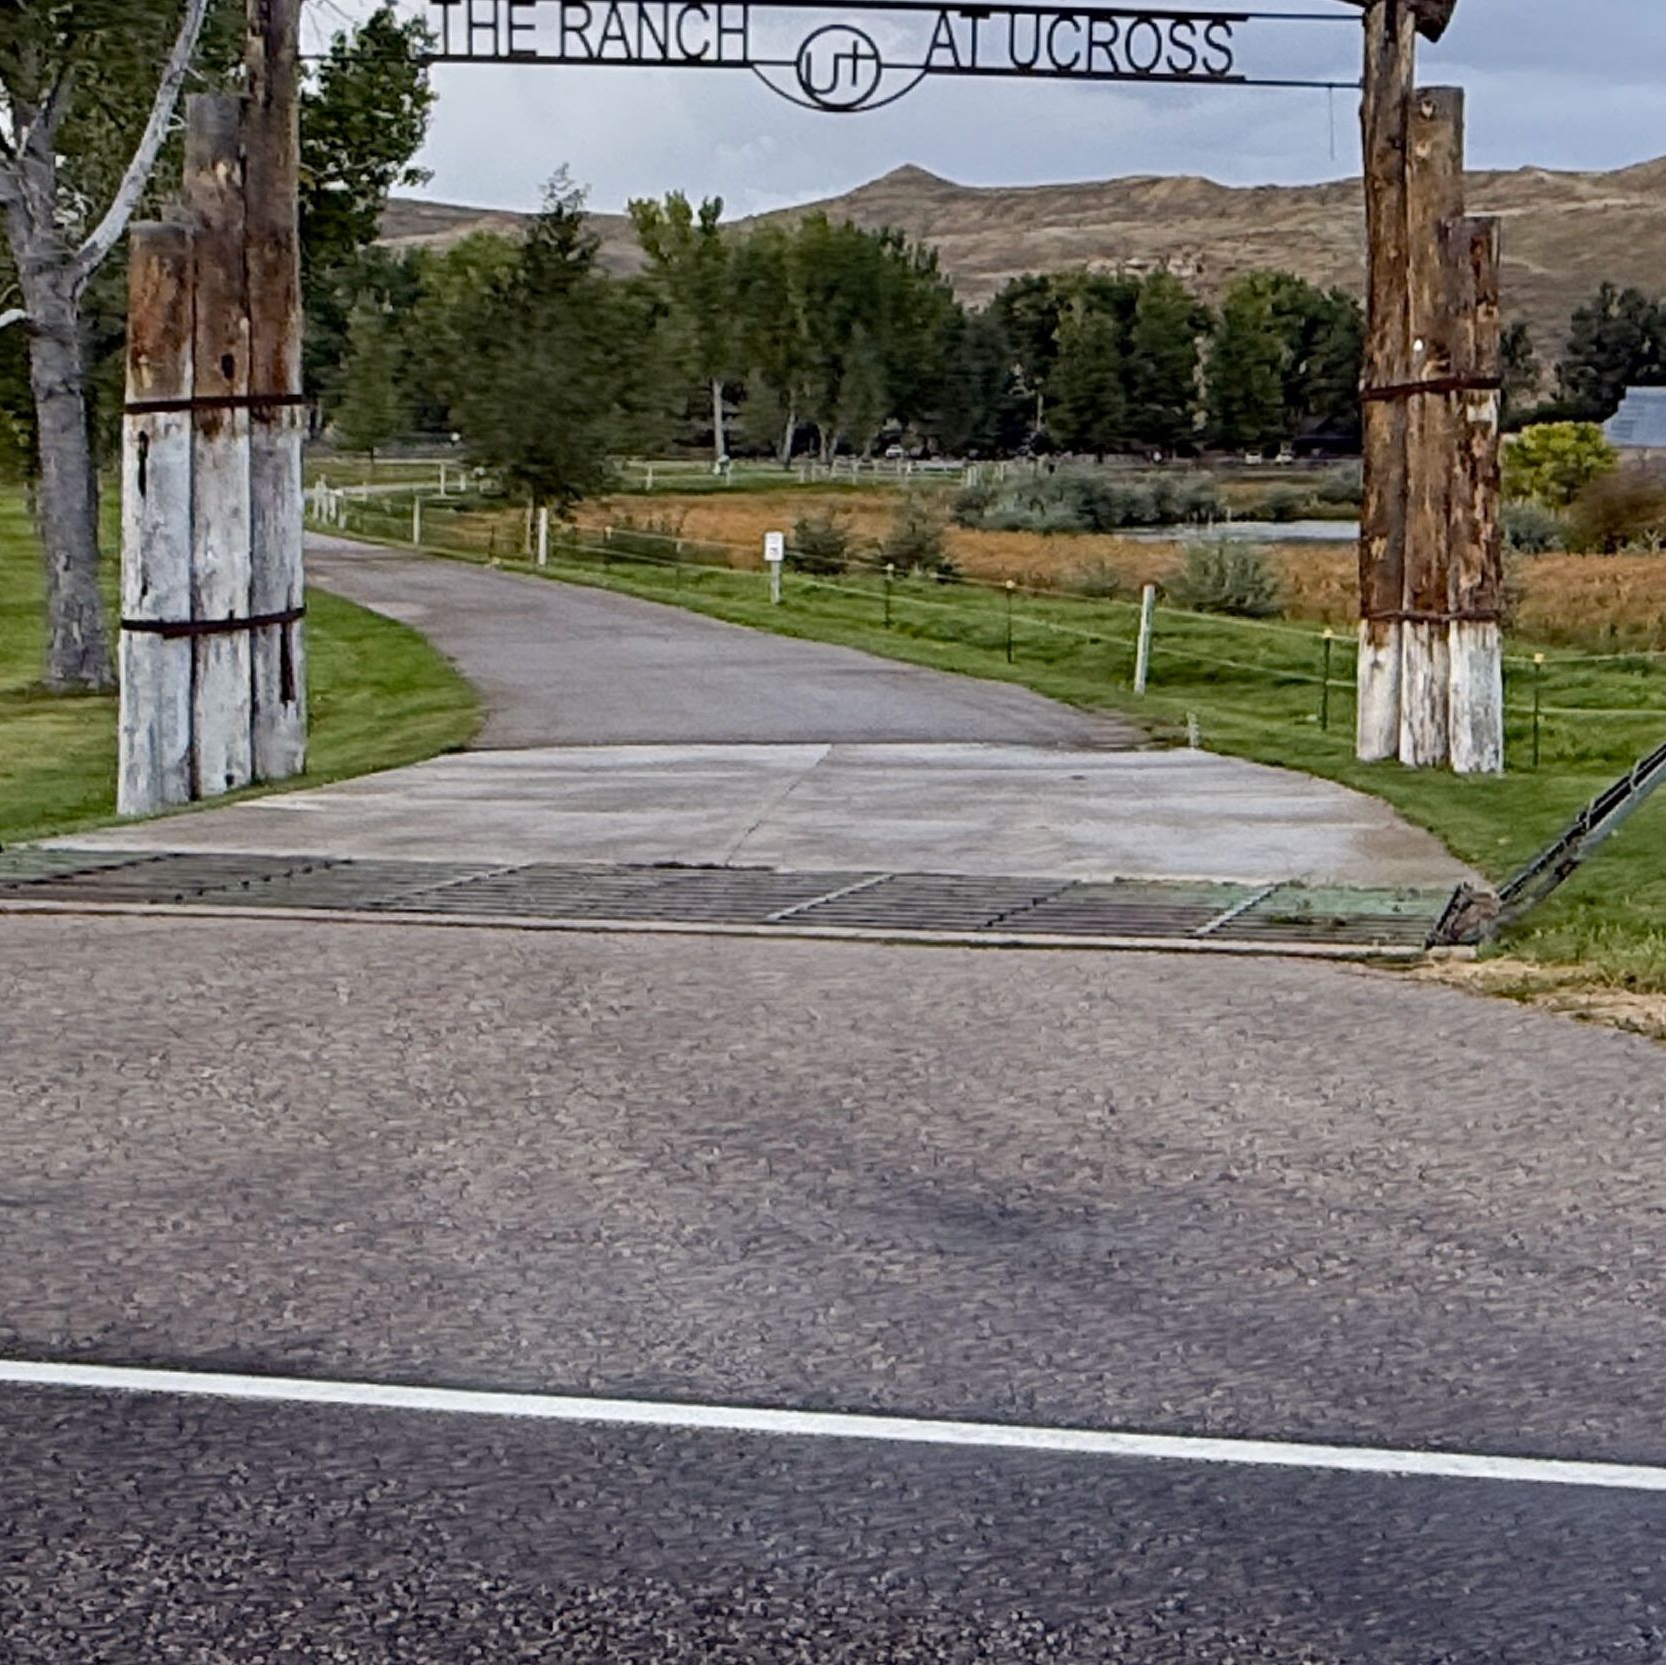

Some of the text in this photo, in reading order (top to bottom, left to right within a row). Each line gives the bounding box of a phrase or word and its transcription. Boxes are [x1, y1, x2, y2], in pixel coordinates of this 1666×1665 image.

[559, 0, 749, 63] RANCH
[924, 8, 990, 70] AT
[1008, 12, 1235, 76] UCROSS
